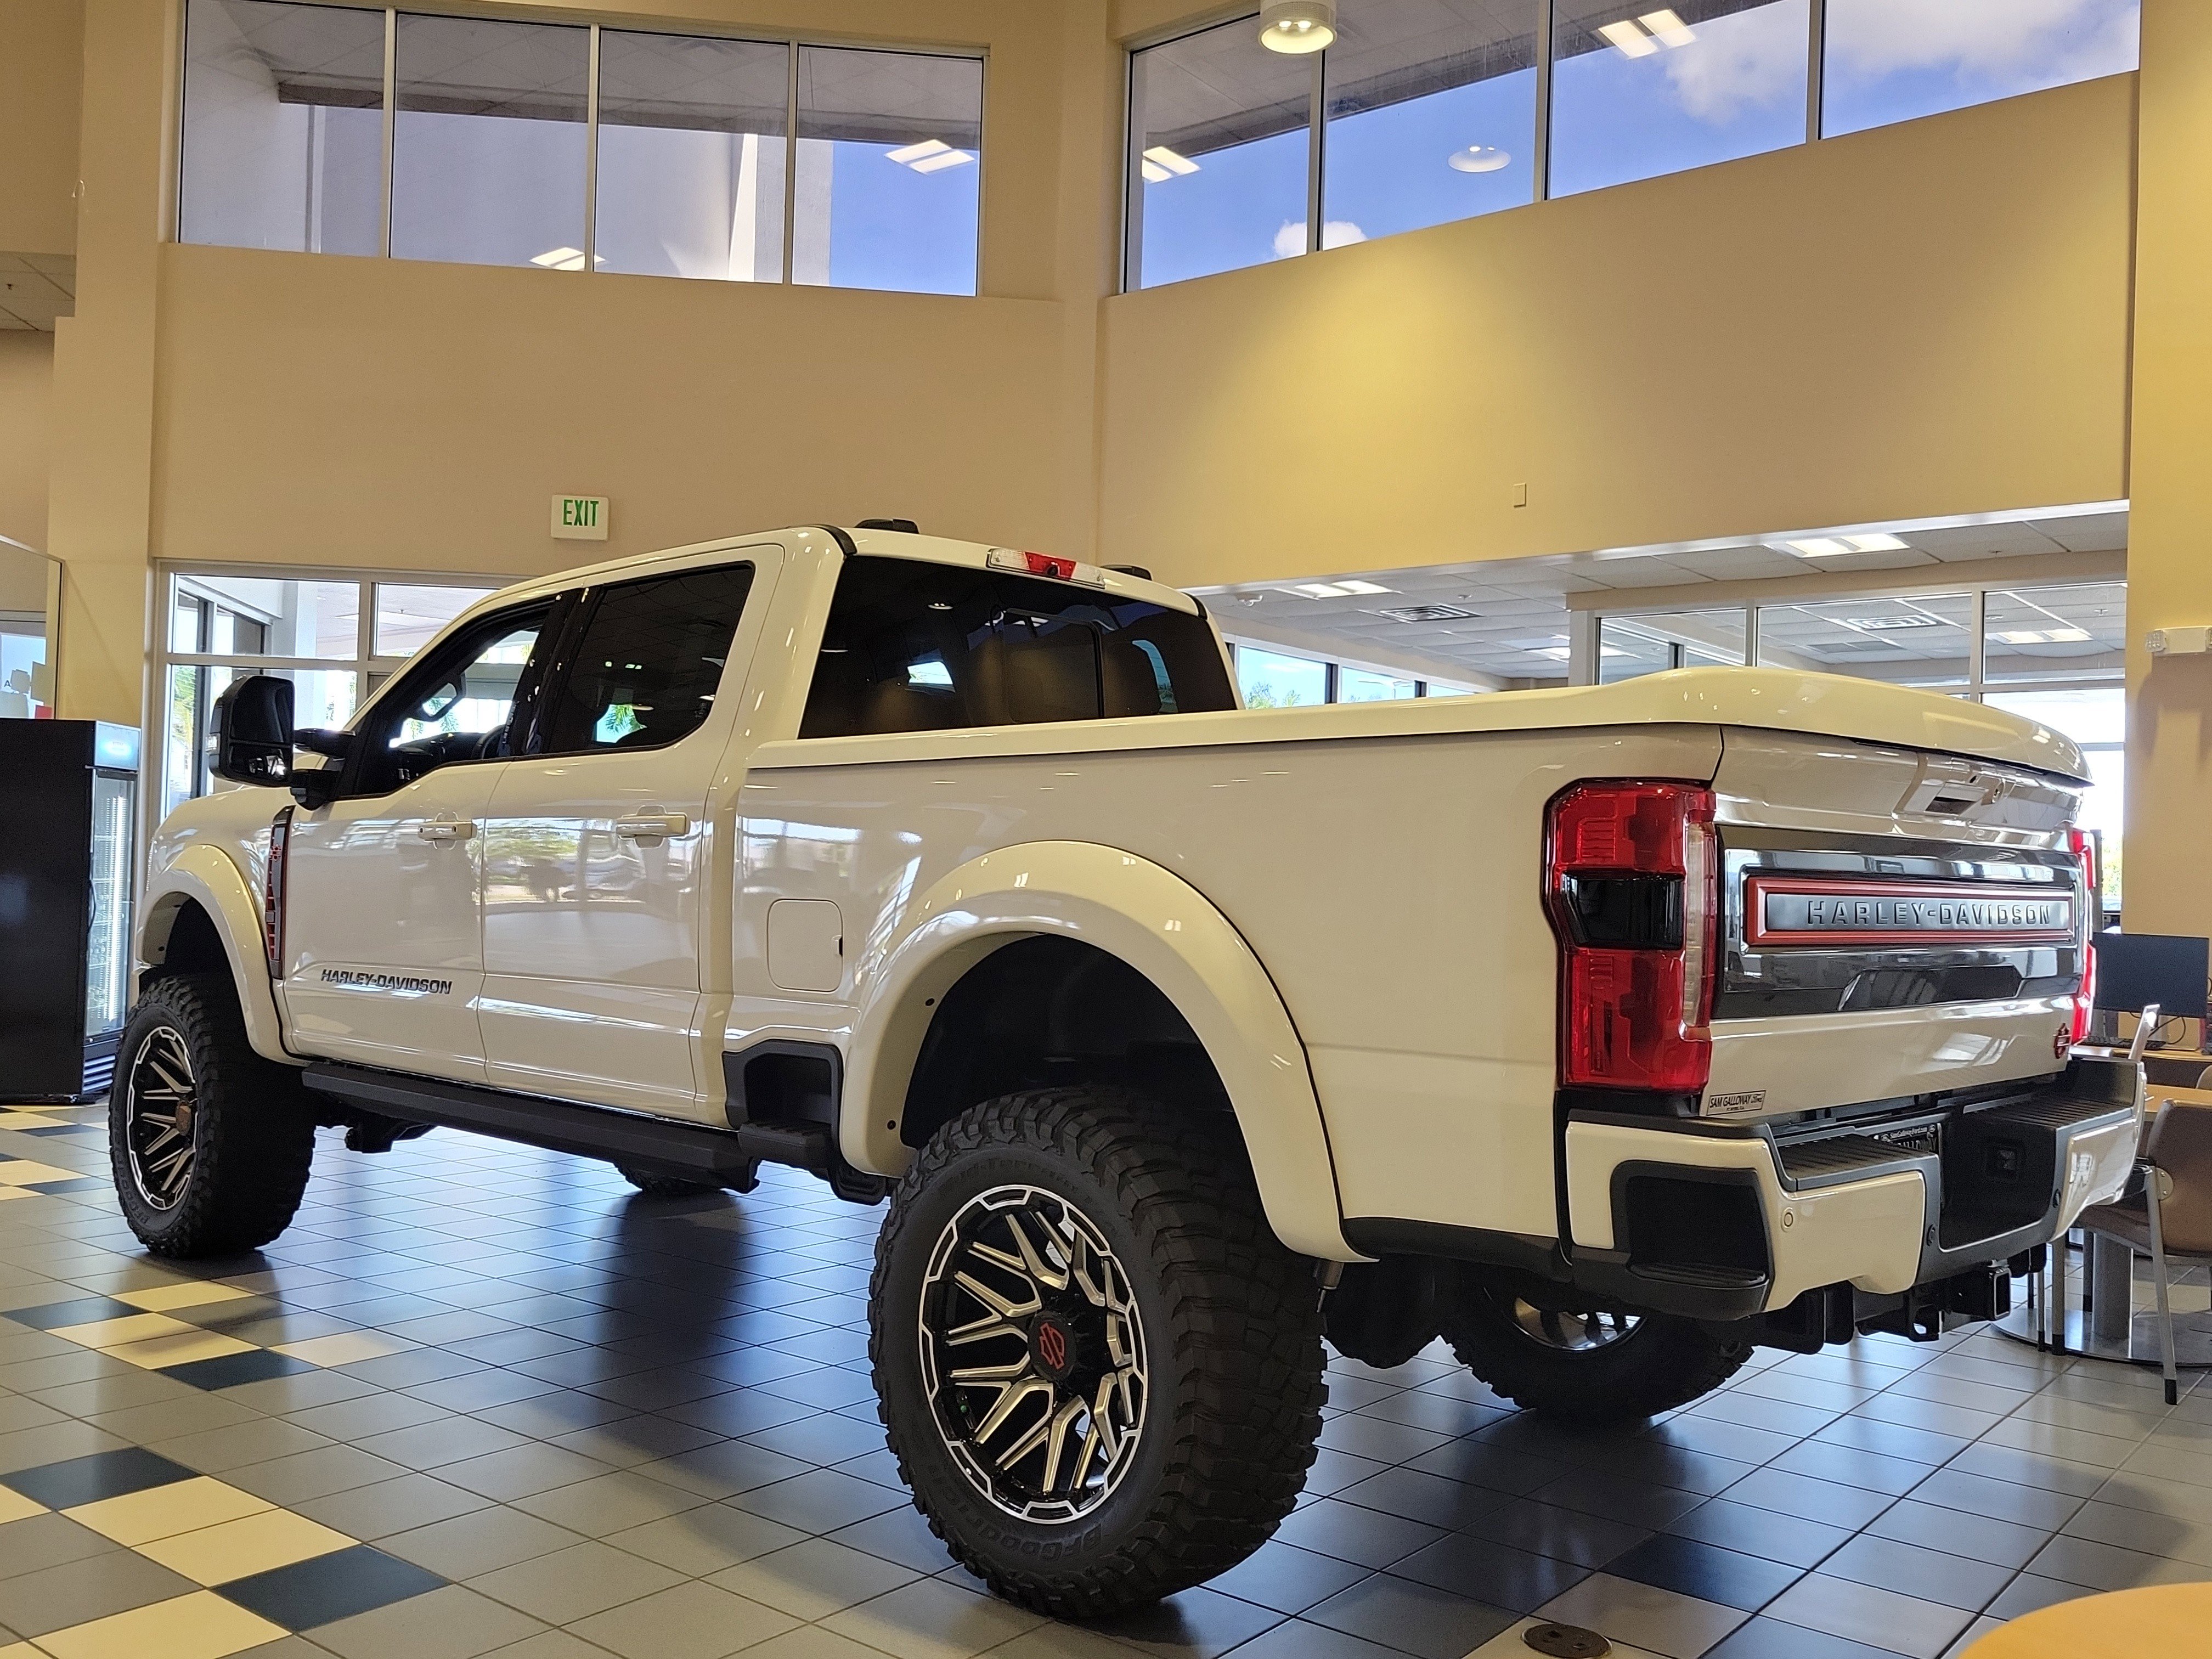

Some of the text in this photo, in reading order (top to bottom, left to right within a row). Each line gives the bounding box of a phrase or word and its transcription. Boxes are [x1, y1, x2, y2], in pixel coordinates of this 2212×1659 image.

[563, 499, 599, 526] EXIT
[1807, 900, 2050, 925] HARLEY-DAVIDSON
[321, 969, 453, 994] HARLEY-DAVIDSON
[1709, 1097, 1723, 1108] SAM
[1723, 1094, 1752, 1107] GALLOWAY
